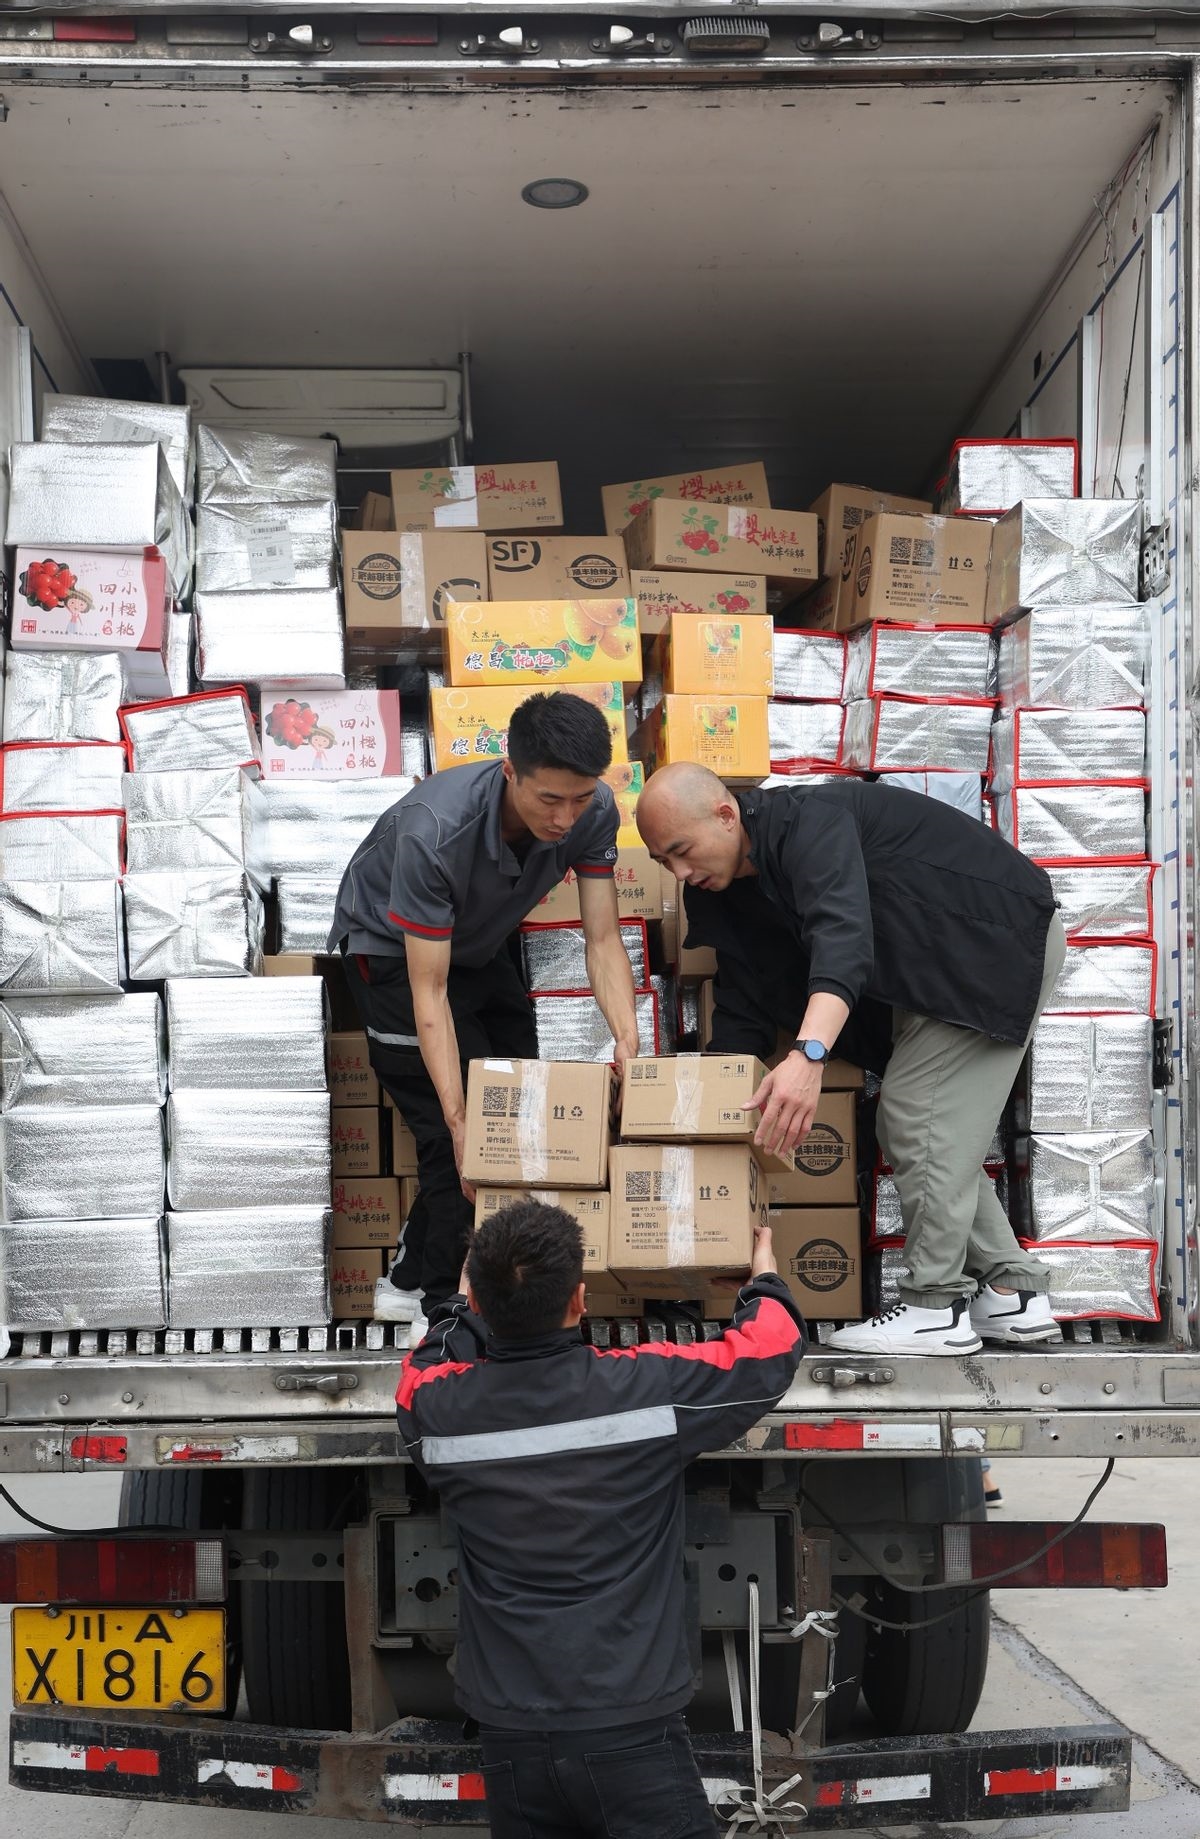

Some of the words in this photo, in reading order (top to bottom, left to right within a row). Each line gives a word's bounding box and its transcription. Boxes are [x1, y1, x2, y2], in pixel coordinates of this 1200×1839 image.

[492, 540, 529, 562] SF
[722, 1112, 741, 1121] 快递
[797, 1260, 848, 1271] 顺丰抢鲜送
[25, 1647, 213, 1703] X1816
